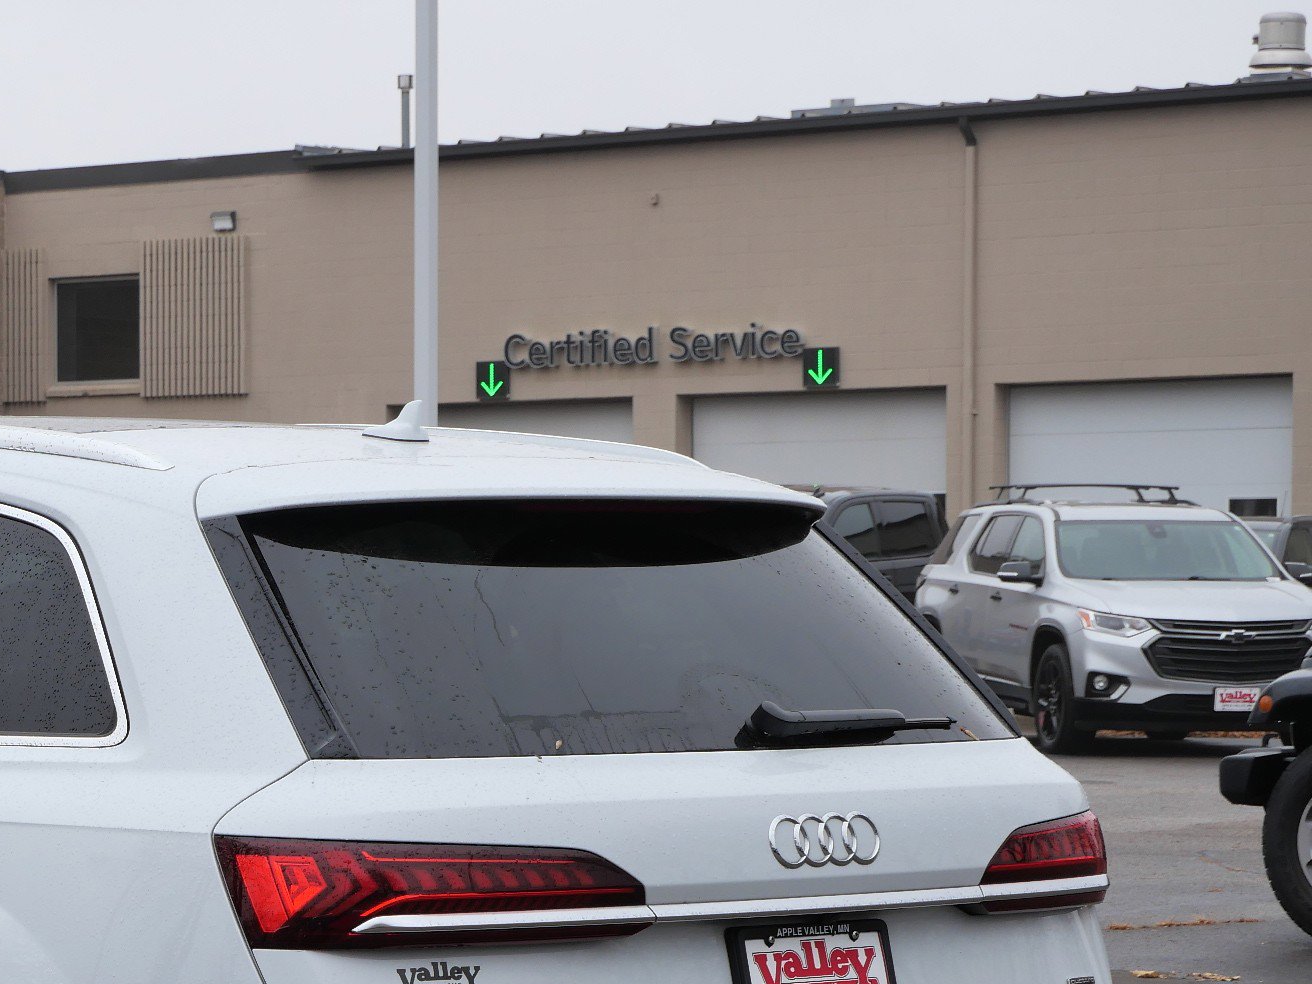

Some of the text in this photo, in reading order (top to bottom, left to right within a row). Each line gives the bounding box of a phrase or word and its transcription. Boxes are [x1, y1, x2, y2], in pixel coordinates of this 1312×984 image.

[503, 322, 803, 369] Certified Service
[776, 924, 850, 937] APPLE VALLEY, MN
